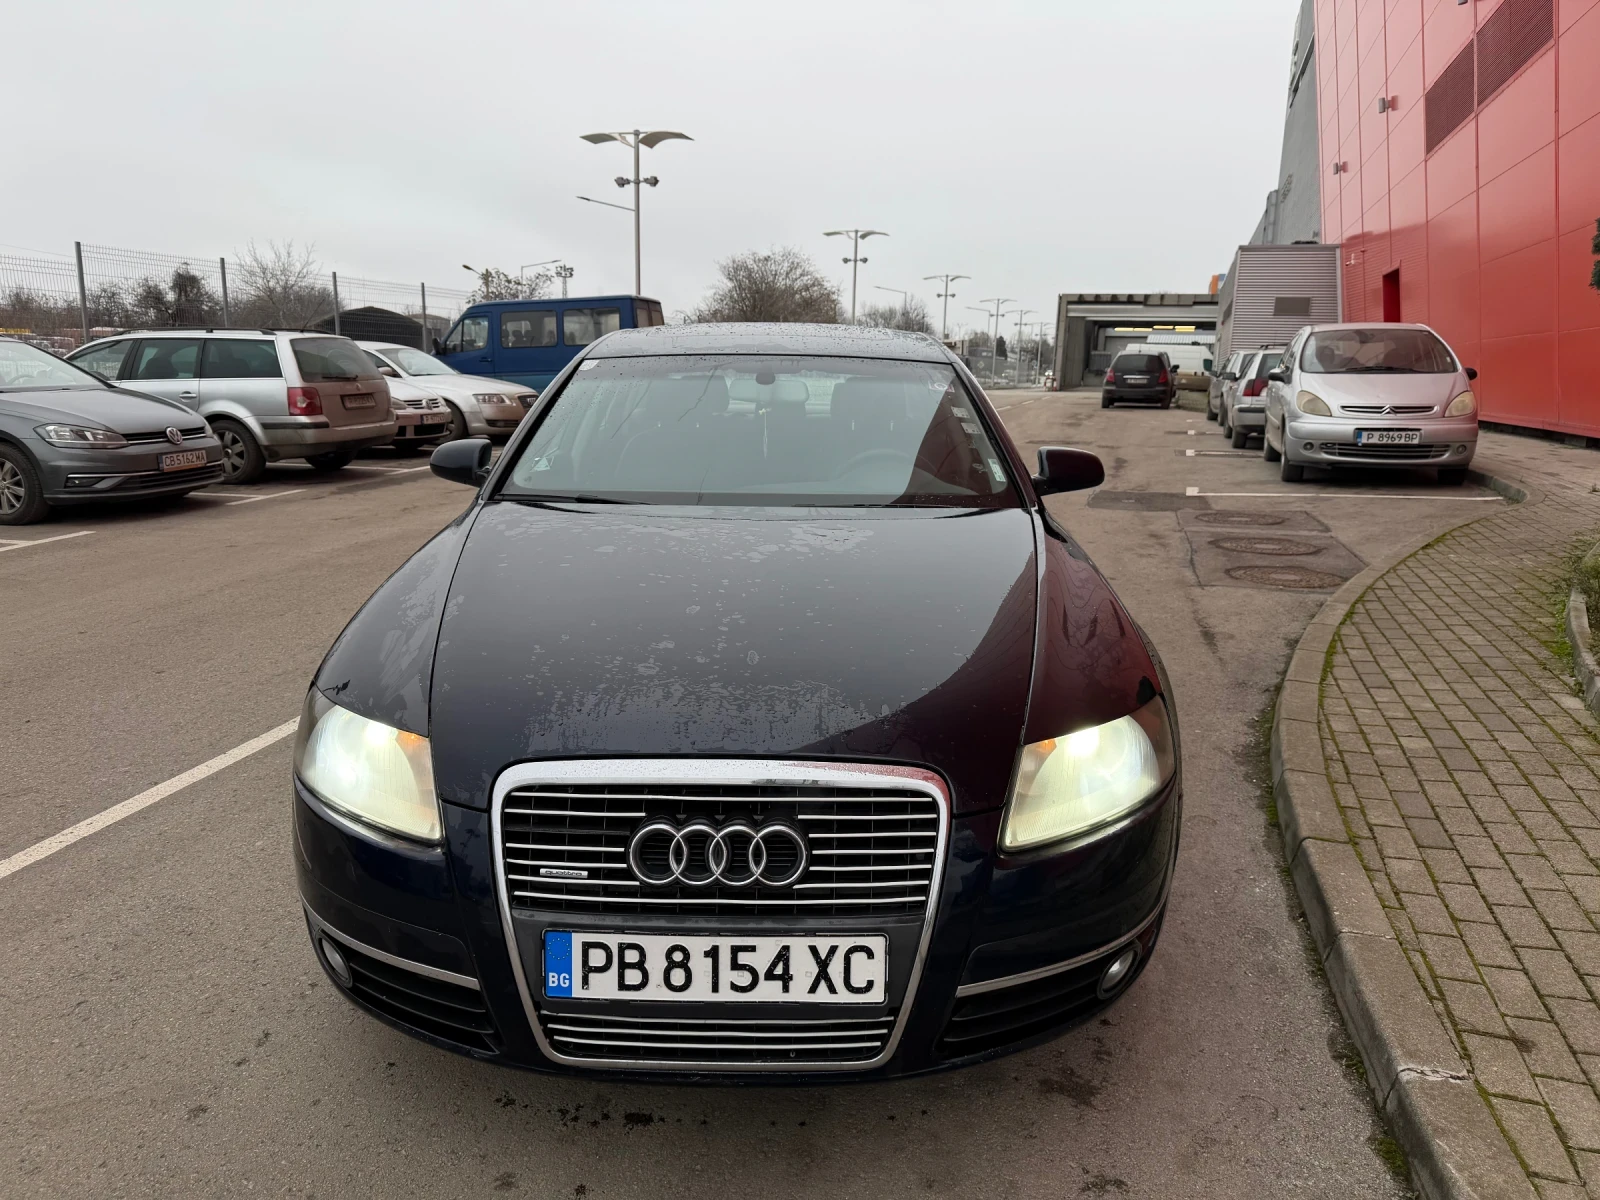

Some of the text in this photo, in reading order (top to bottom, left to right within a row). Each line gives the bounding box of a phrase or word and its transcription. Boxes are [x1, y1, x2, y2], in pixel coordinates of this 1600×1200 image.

[1367, 433, 1418, 442] P 8969 BP
[581, 940, 875, 995] PB 8154 XC
[548, 972, 570, 988] BG
